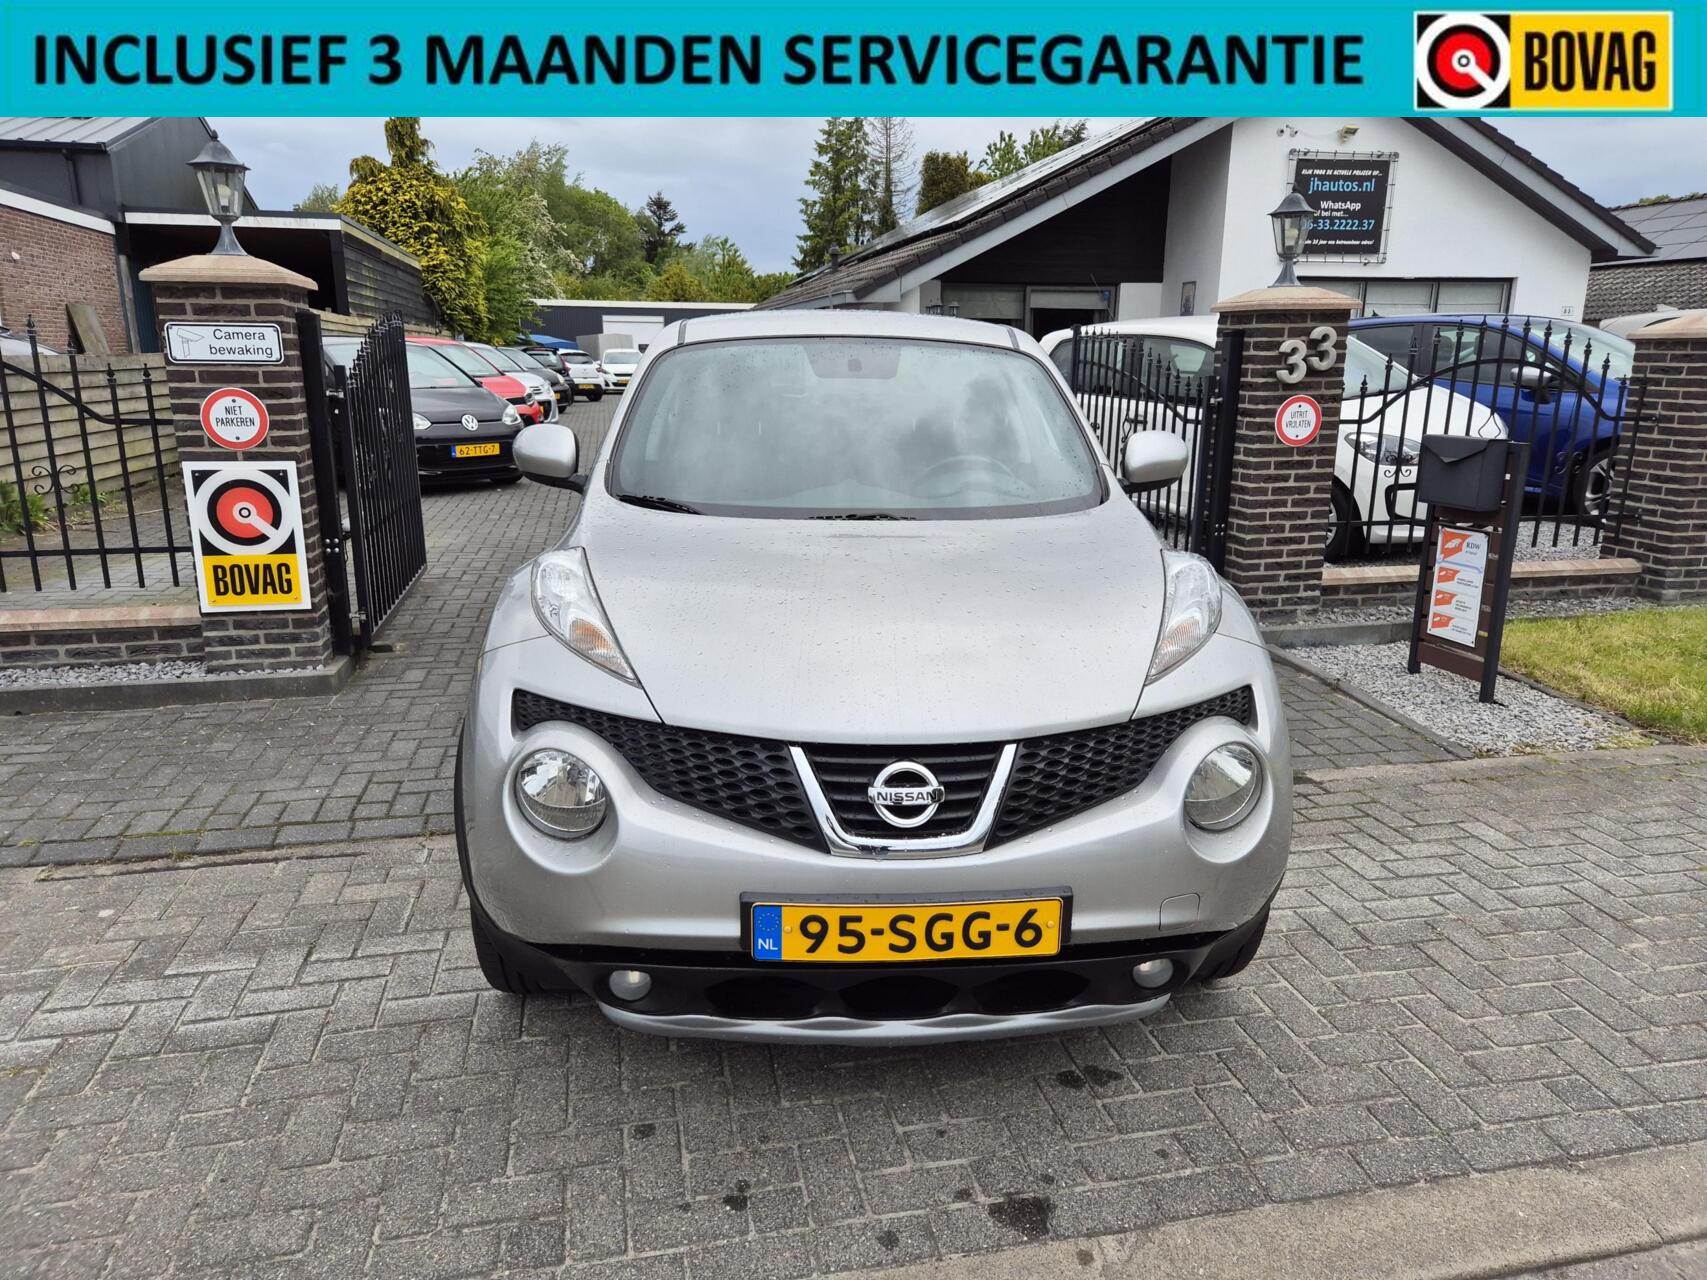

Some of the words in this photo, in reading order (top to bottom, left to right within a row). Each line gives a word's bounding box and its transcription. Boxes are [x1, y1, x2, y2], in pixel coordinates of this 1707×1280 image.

[1308, 177, 1375, 194] jhautos.nl
[1320, 200, 1361, 211] WhatsApp
[213, 328, 265, 341] Camera
[209, 344, 273, 358] bewaking
[1276, 326, 1337, 384] 33
[224, 406, 243, 416] NIET
[1290, 410, 1308, 419] UITRIT
[215, 417, 255, 427] PARKEREN
[459, 445, 496, 455] 62-TTG-7
[213, 563, 293, 597] BOVAG
[876, 791, 937, 802] NISSAN
[757, 937, 778, 951] NL
[799, 908, 1044, 954] 95-SGG-6
